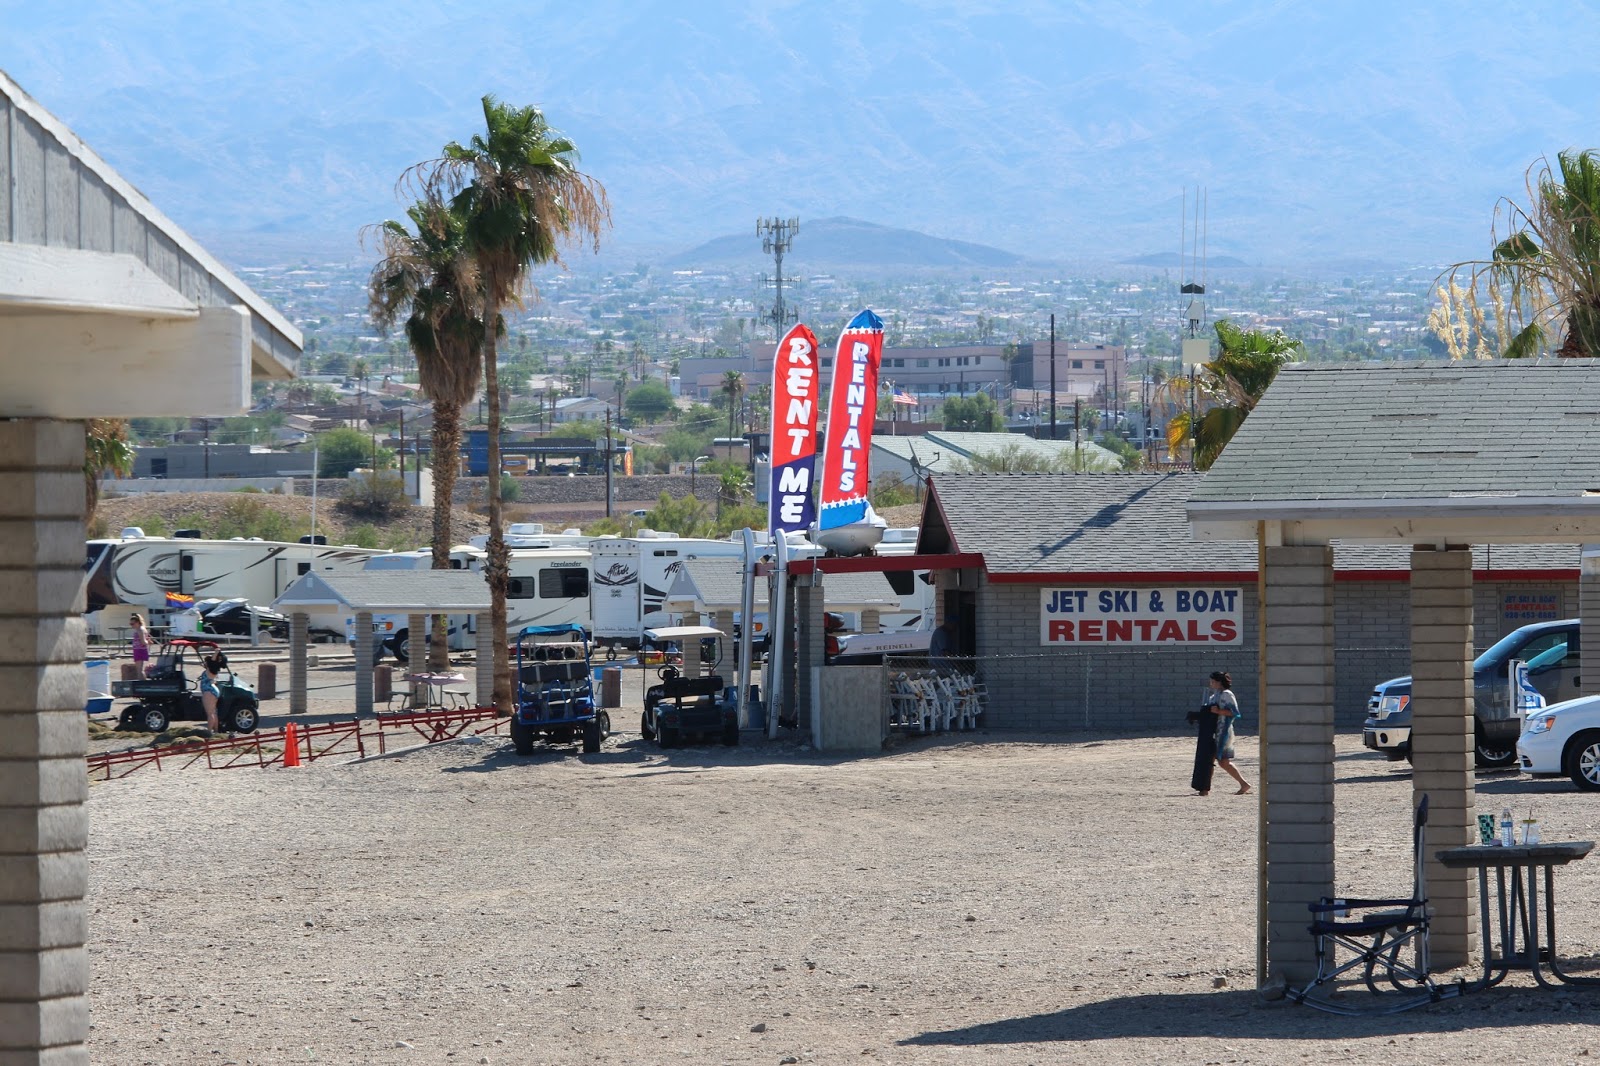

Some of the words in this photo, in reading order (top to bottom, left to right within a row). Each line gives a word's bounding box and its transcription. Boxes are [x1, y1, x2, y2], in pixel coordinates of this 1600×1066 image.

[786, 338, 813, 456] RENT
[839, 341, 870, 492] RENTALS
[778, 466, 810, 523] ME
[1046, 590, 1088, 613] JET
[1098, 590, 1138, 613] SKI
[1149, 590, 1165, 613] &
[1176, 590, 1238, 613] BOAT
[1504, 595, 1517, 603] JET
[1519, 595, 1530, 603] SKI
[1539, 595, 1557, 603] BOAT
[1505, 603, 1557, 611] RENTALS
[1048, 619, 1238, 642] RENTALS
[875, 643, 915, 651] REINELL
